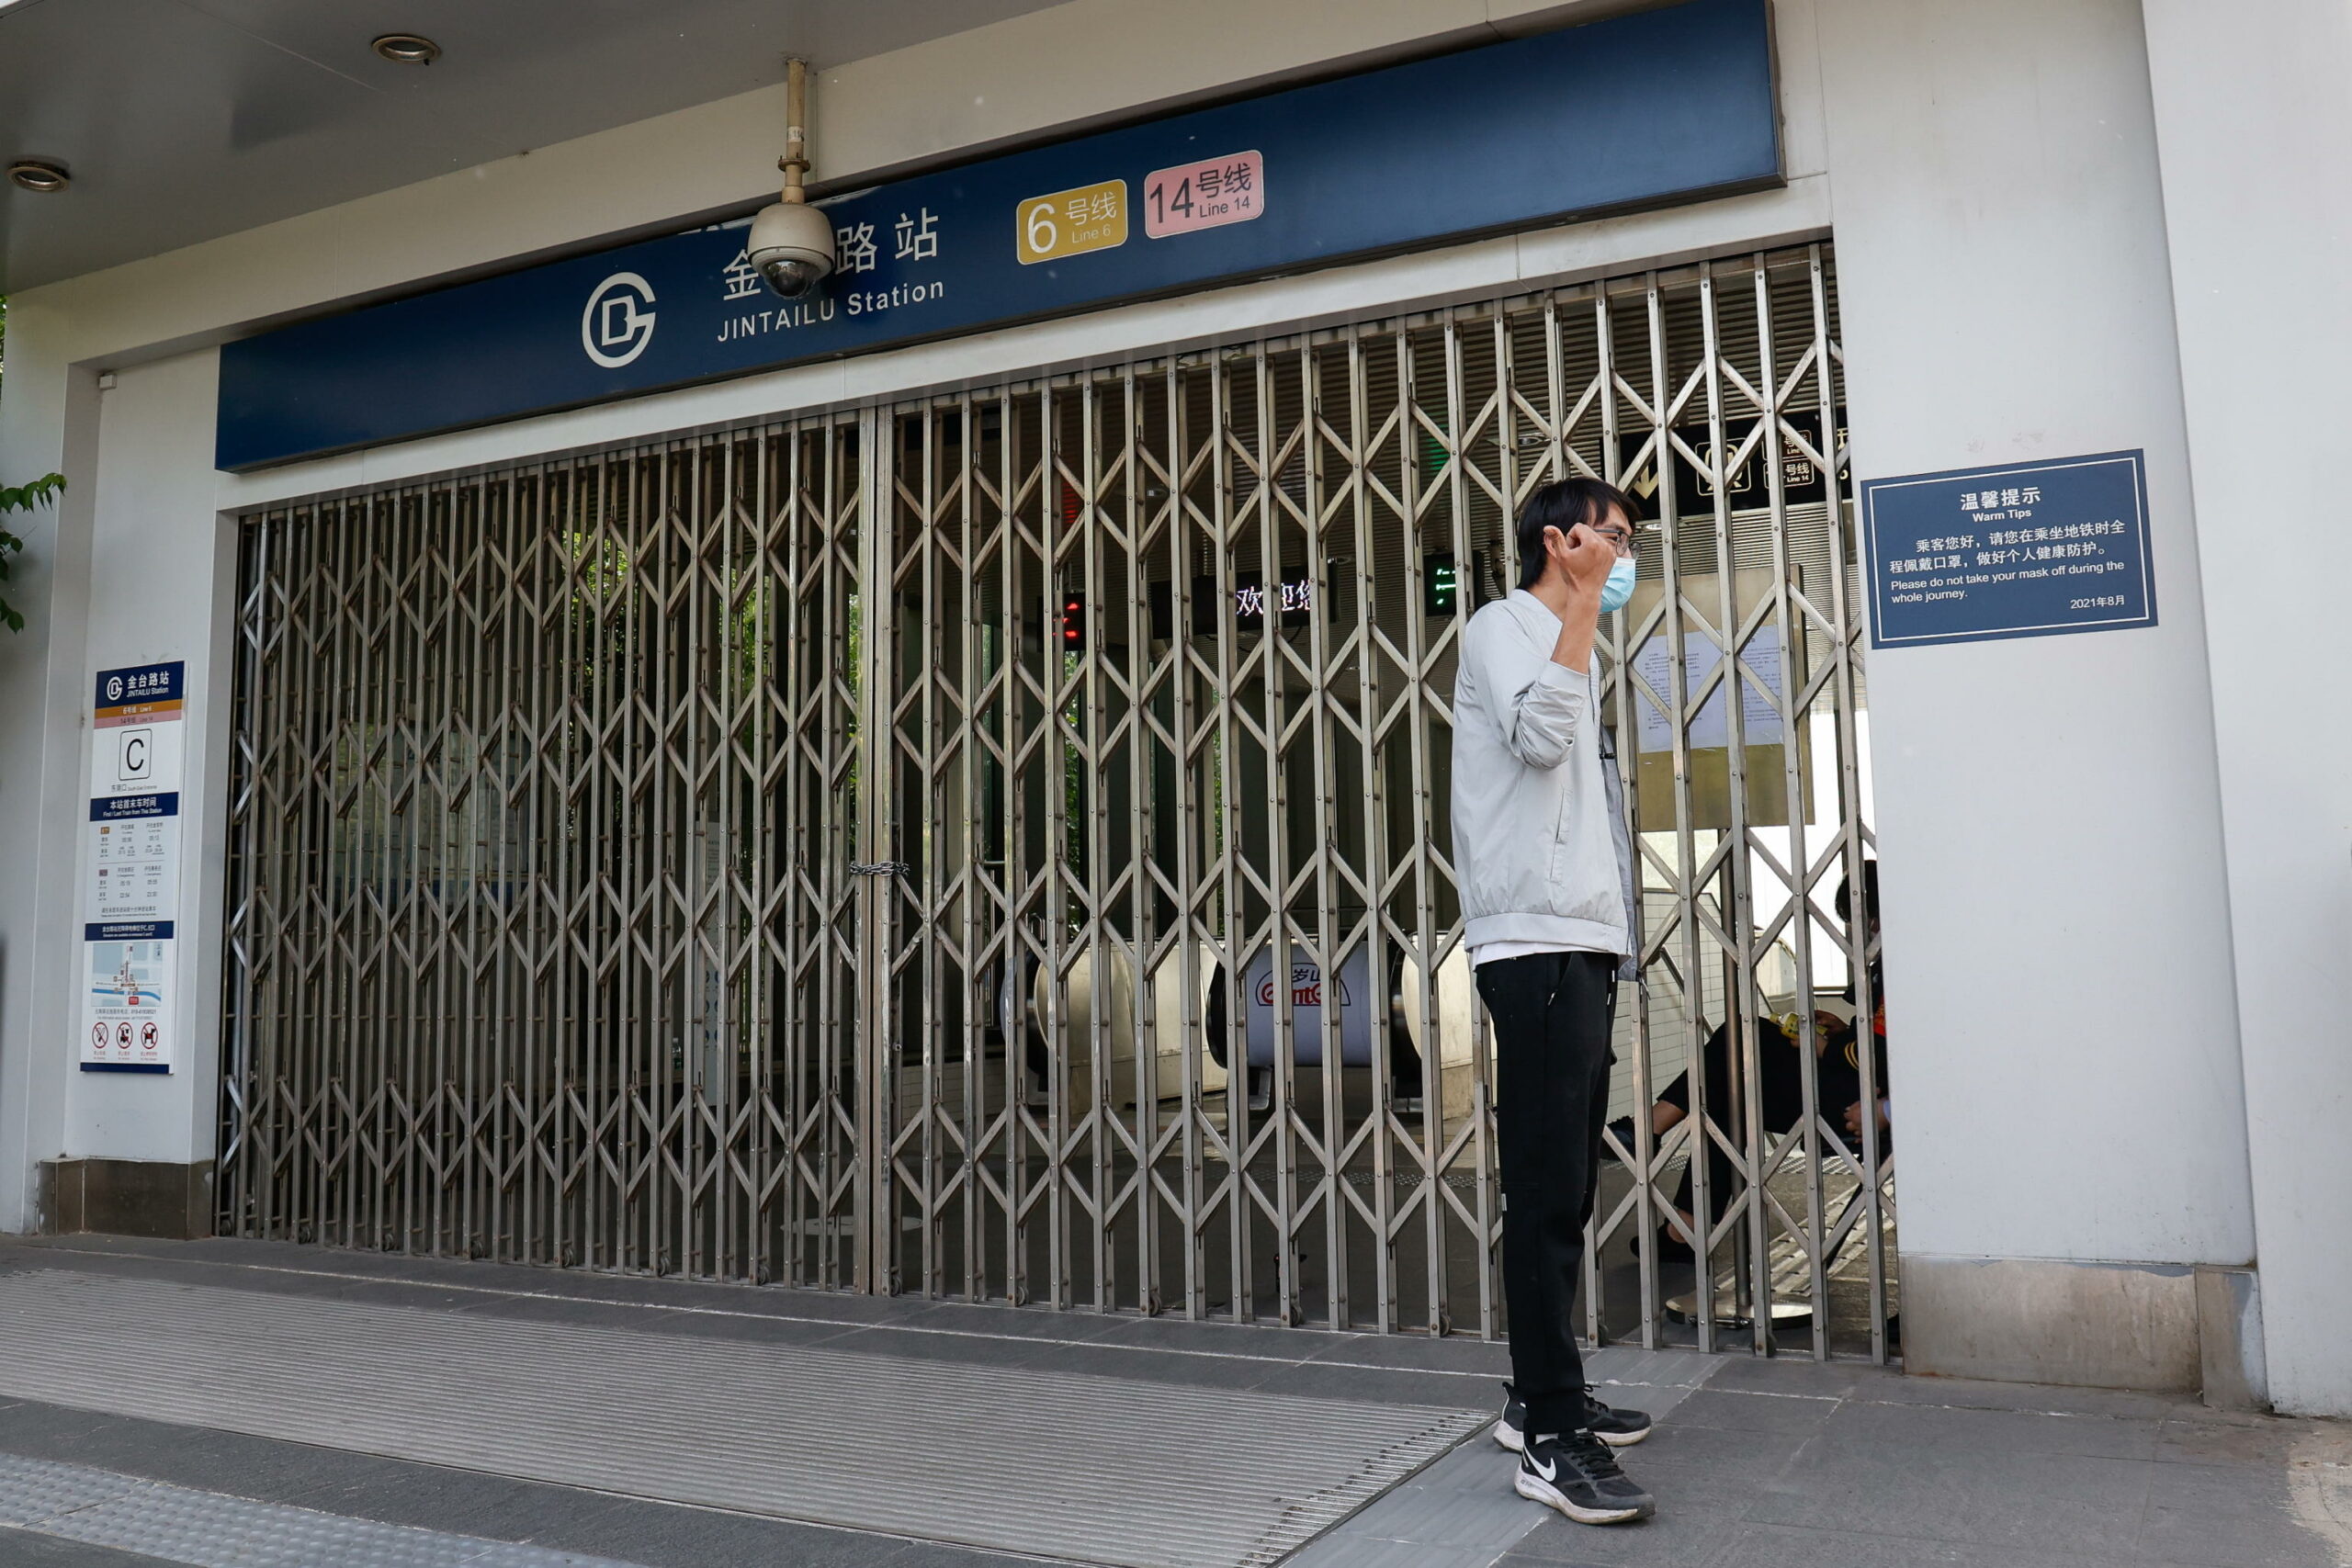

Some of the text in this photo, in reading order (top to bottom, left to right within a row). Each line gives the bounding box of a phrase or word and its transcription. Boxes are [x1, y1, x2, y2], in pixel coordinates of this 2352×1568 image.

[1199, 196, 1250, 219] Line 14
[1071, 223, 1112, 244] Line 6
[722, 207, 939, 301] 金路站
[717, 281, 944, 343] JINTAILU Station
[1960, 487, 2041, 511] 温馨提示
[1973, 509, 2032, 523] Warm Tips
[1891, 560, 2125, 591] Please do not take your mask off during the
[1892, 590, 1968, 604] whole journey.
[2070, 595, 2125, 609] 2021年8月
[127, 671, 170, 690] 金台路站
[127, 686, 169, 697] JINTAILU Station
[126, 738, 144, 772] C
